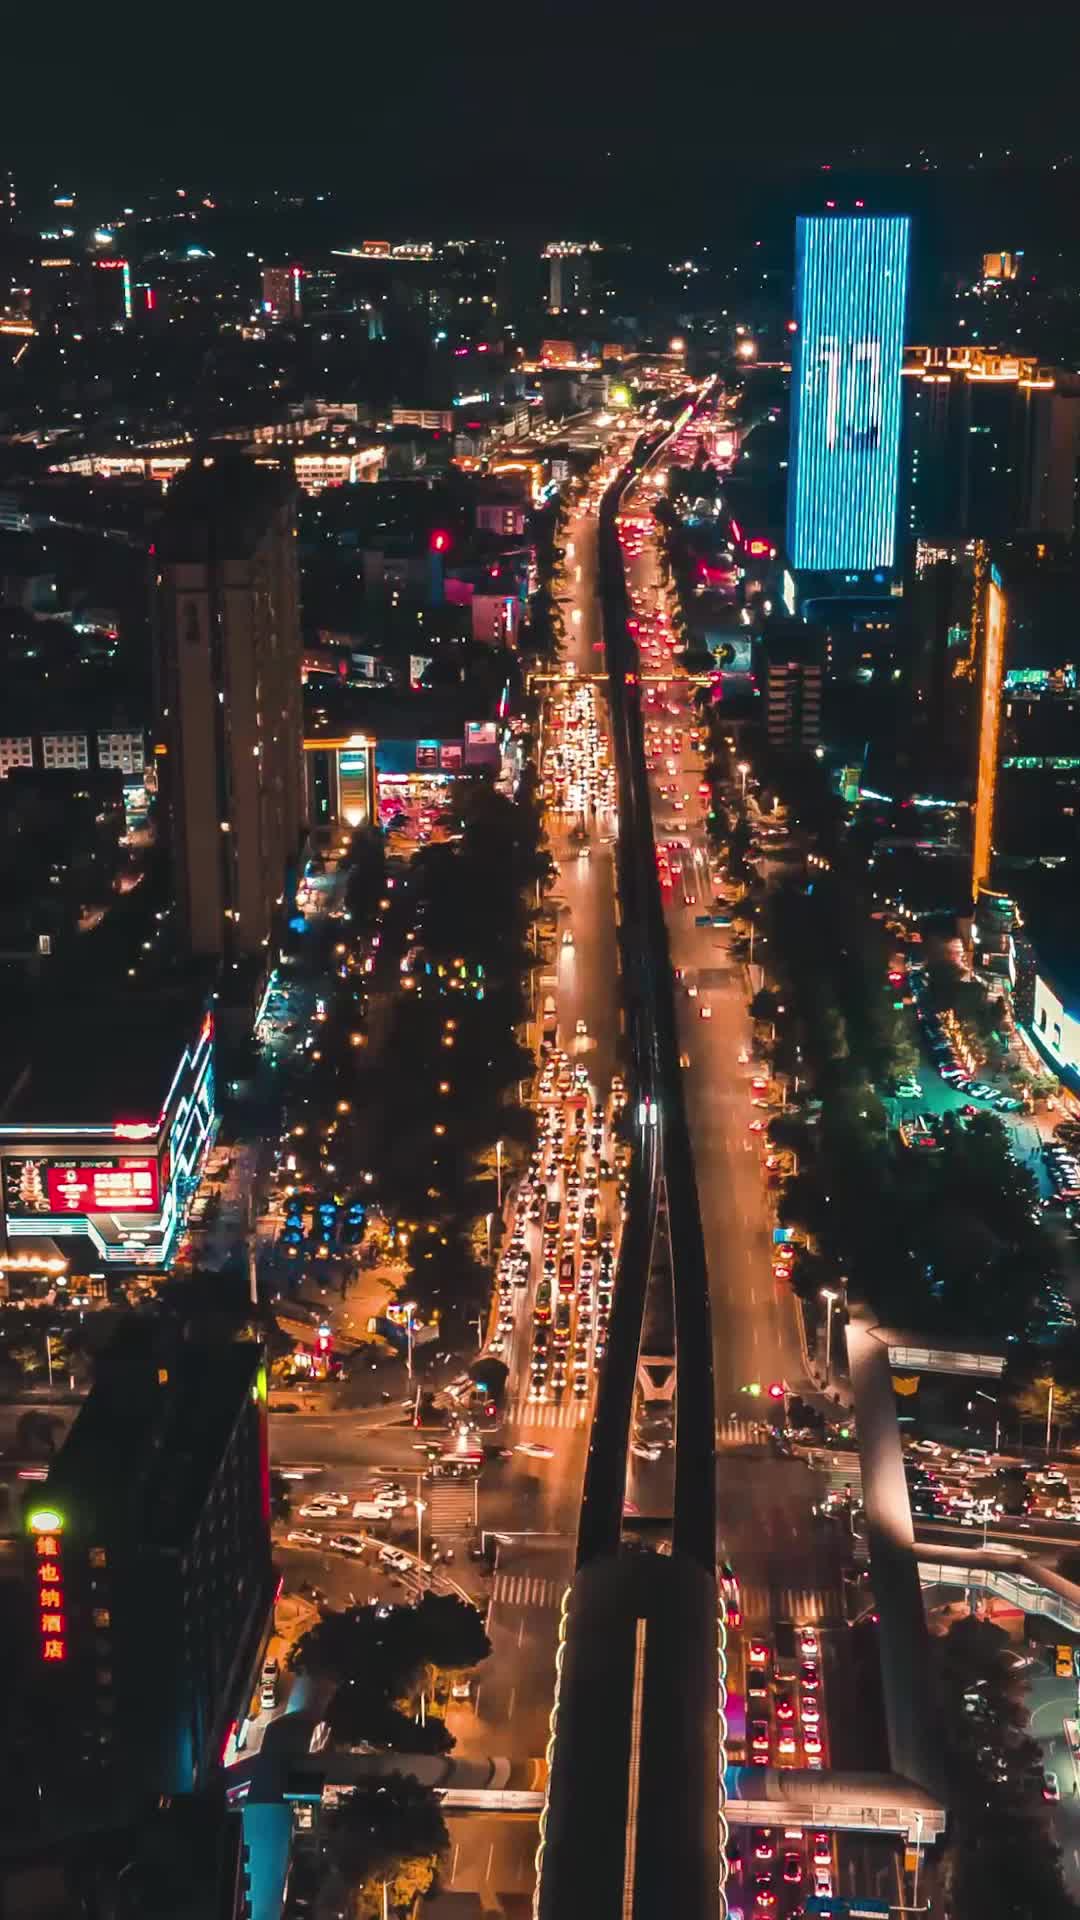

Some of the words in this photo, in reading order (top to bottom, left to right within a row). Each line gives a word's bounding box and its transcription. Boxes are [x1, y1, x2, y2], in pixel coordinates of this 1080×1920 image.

[36, 1535, 64, 1658] 维也纳酒店
